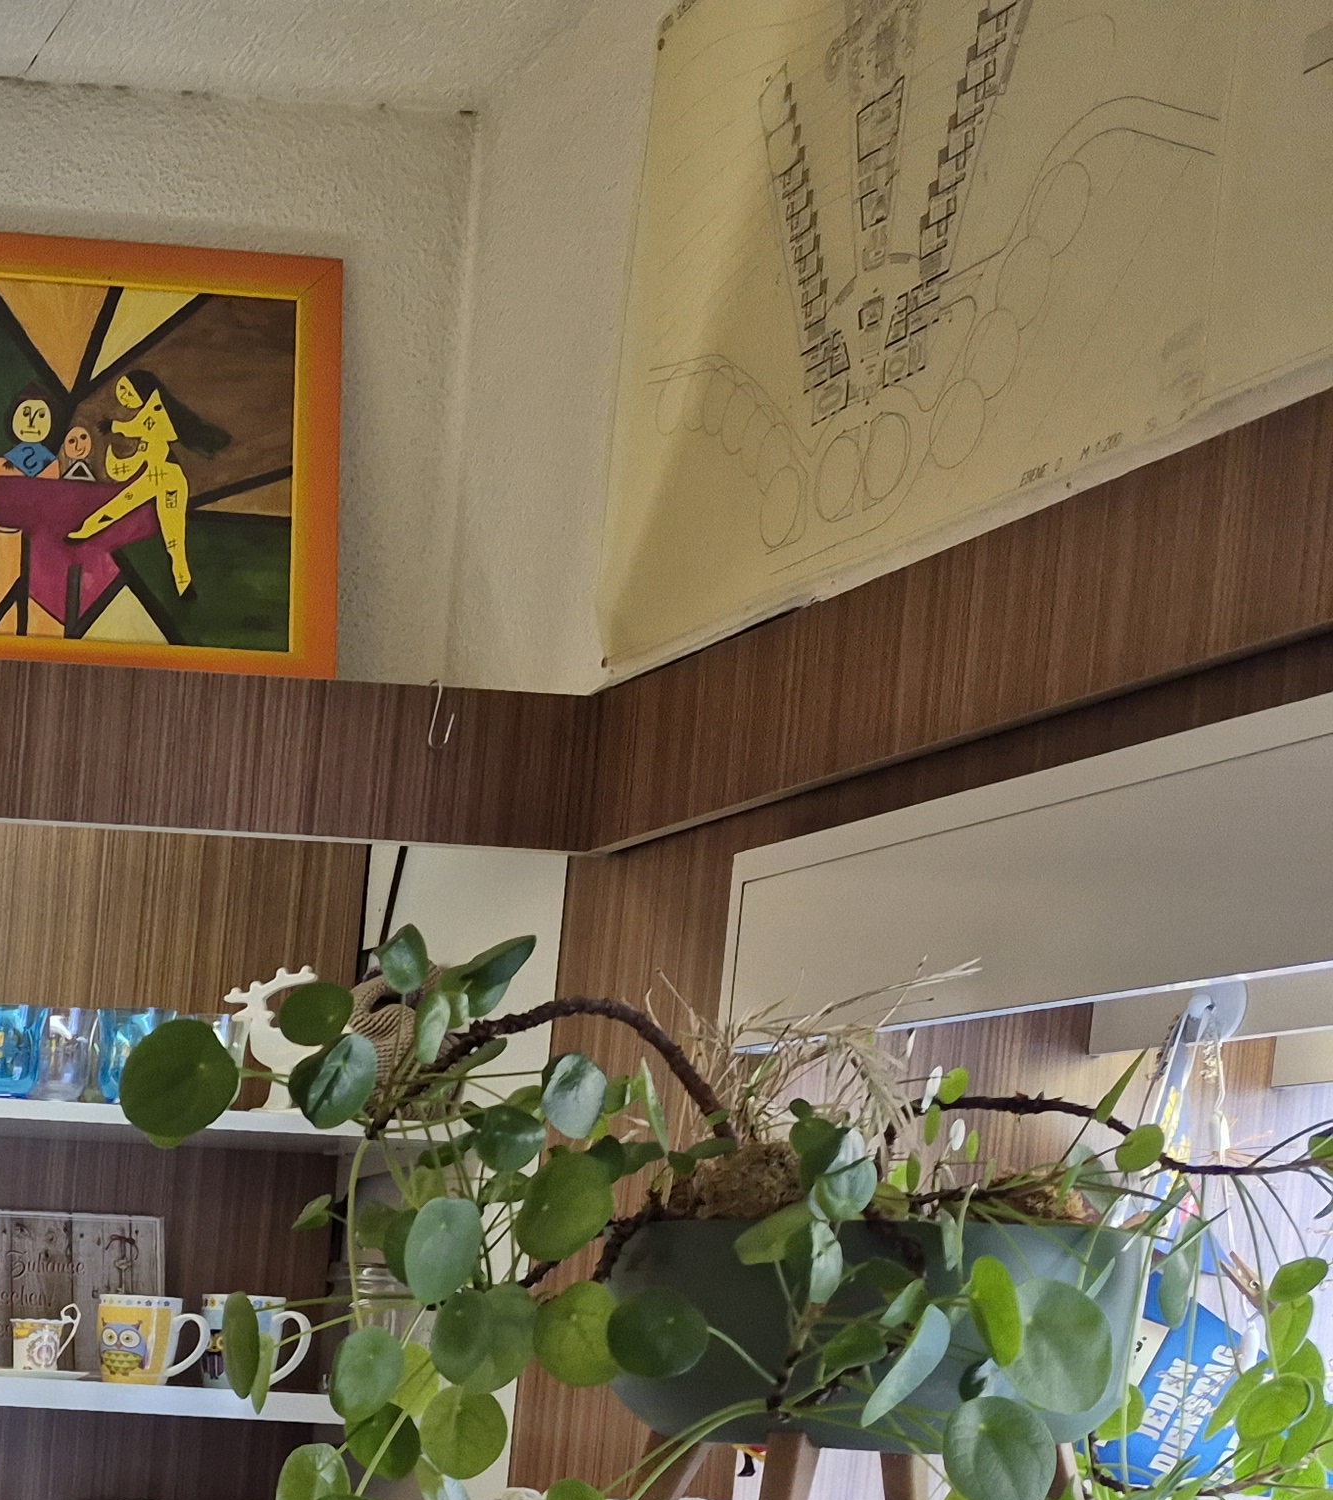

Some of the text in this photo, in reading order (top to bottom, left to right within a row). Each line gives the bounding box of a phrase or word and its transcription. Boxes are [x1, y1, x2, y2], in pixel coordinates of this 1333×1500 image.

[6, 1250, 85, 1278] Zuhause
[1137, 1358, 1198, 1440] JEDEN
[1149, 1345, 1234, 1474] DIENSTAG
